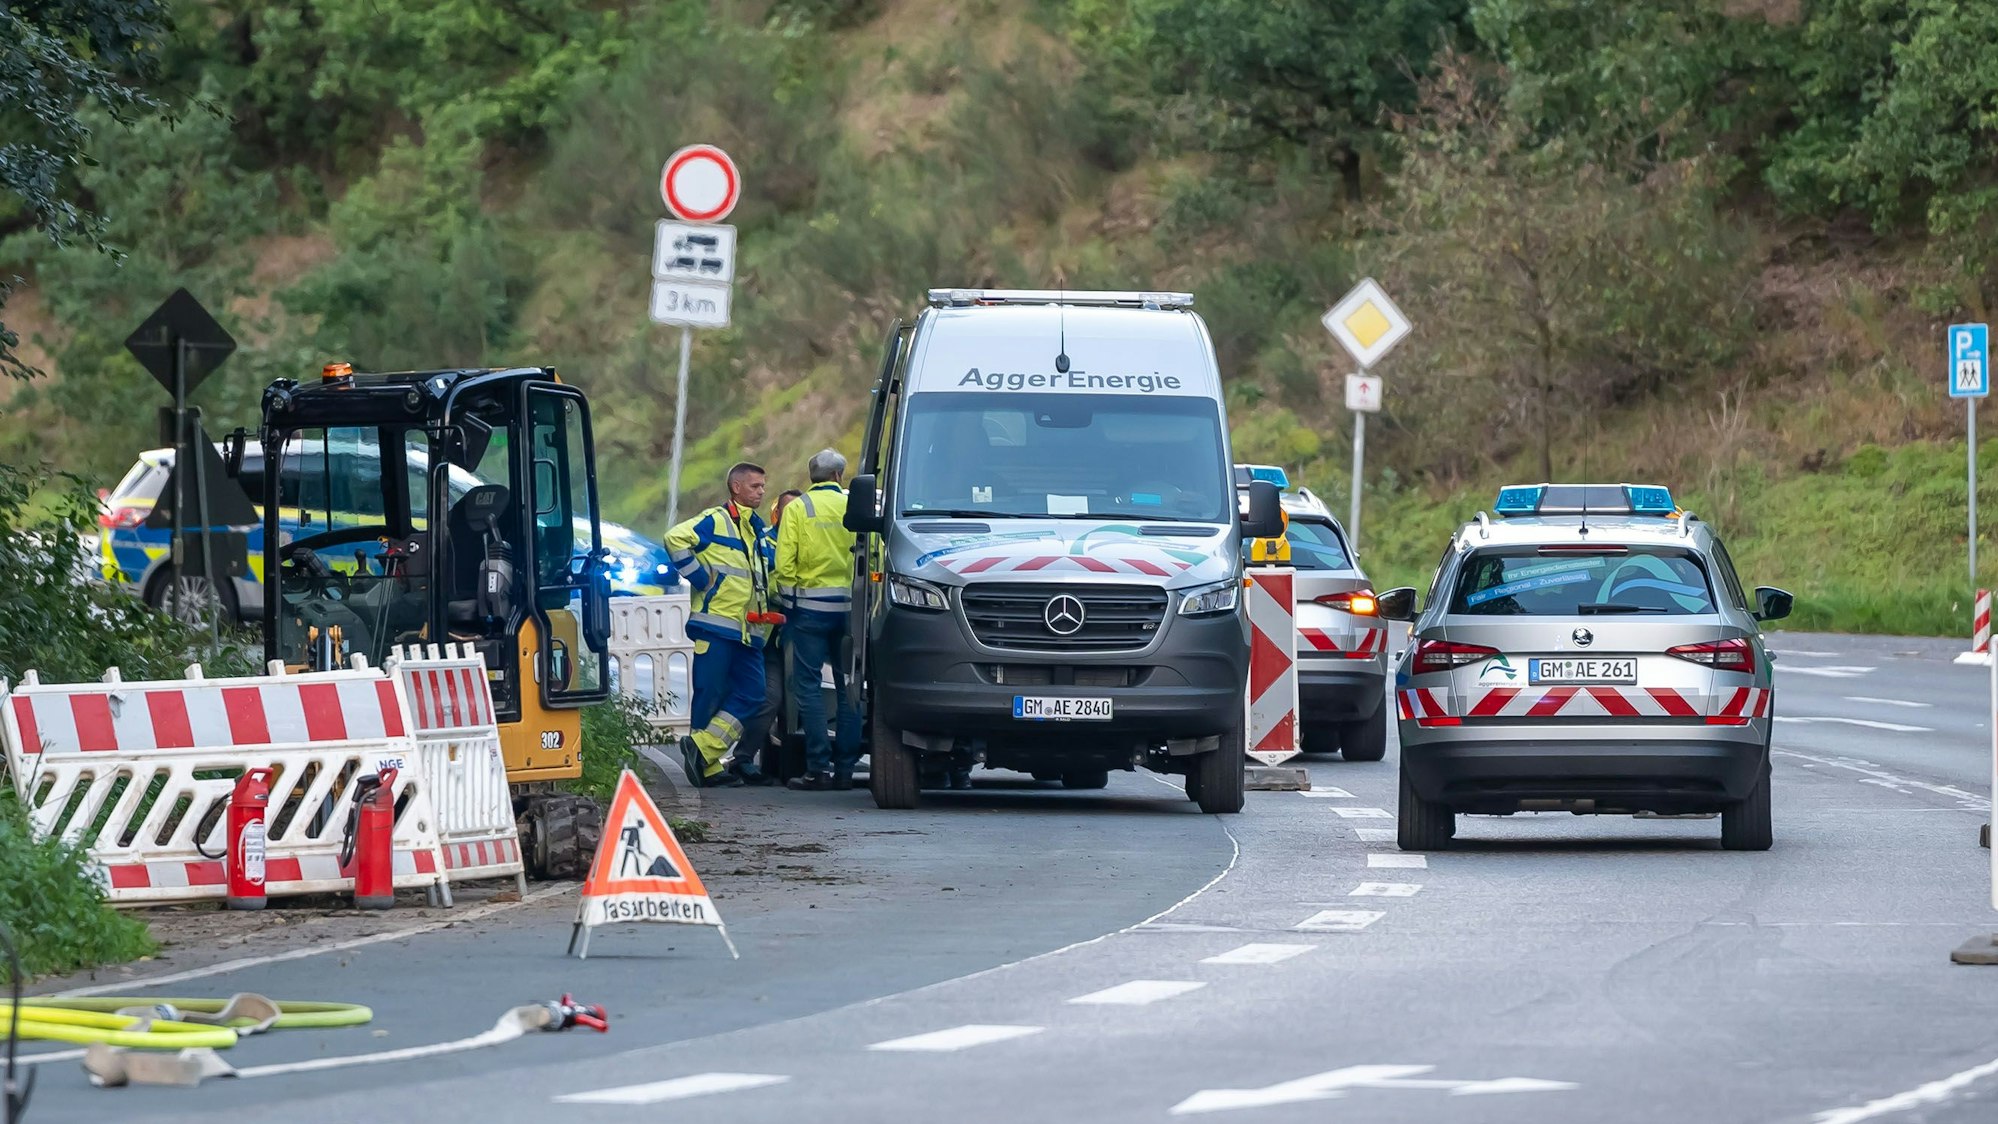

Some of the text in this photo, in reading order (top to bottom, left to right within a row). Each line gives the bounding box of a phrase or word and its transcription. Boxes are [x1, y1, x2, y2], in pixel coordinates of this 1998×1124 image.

[665, 290, 717, 314] 3 km
[1956, 331, 1973, 359] P
[475, 491, 497, 505] CAT
[1470, 593, 1487, 603] Fair
[1494, 581, 1531, 595] Regional
[1540, 661, 1634, 678] GM AE 261
[1024, 699, 1110, 716] GM AE 2840
[541, 731, 560, 749] 302
[603, 895, 704, 920] asarbeiten
